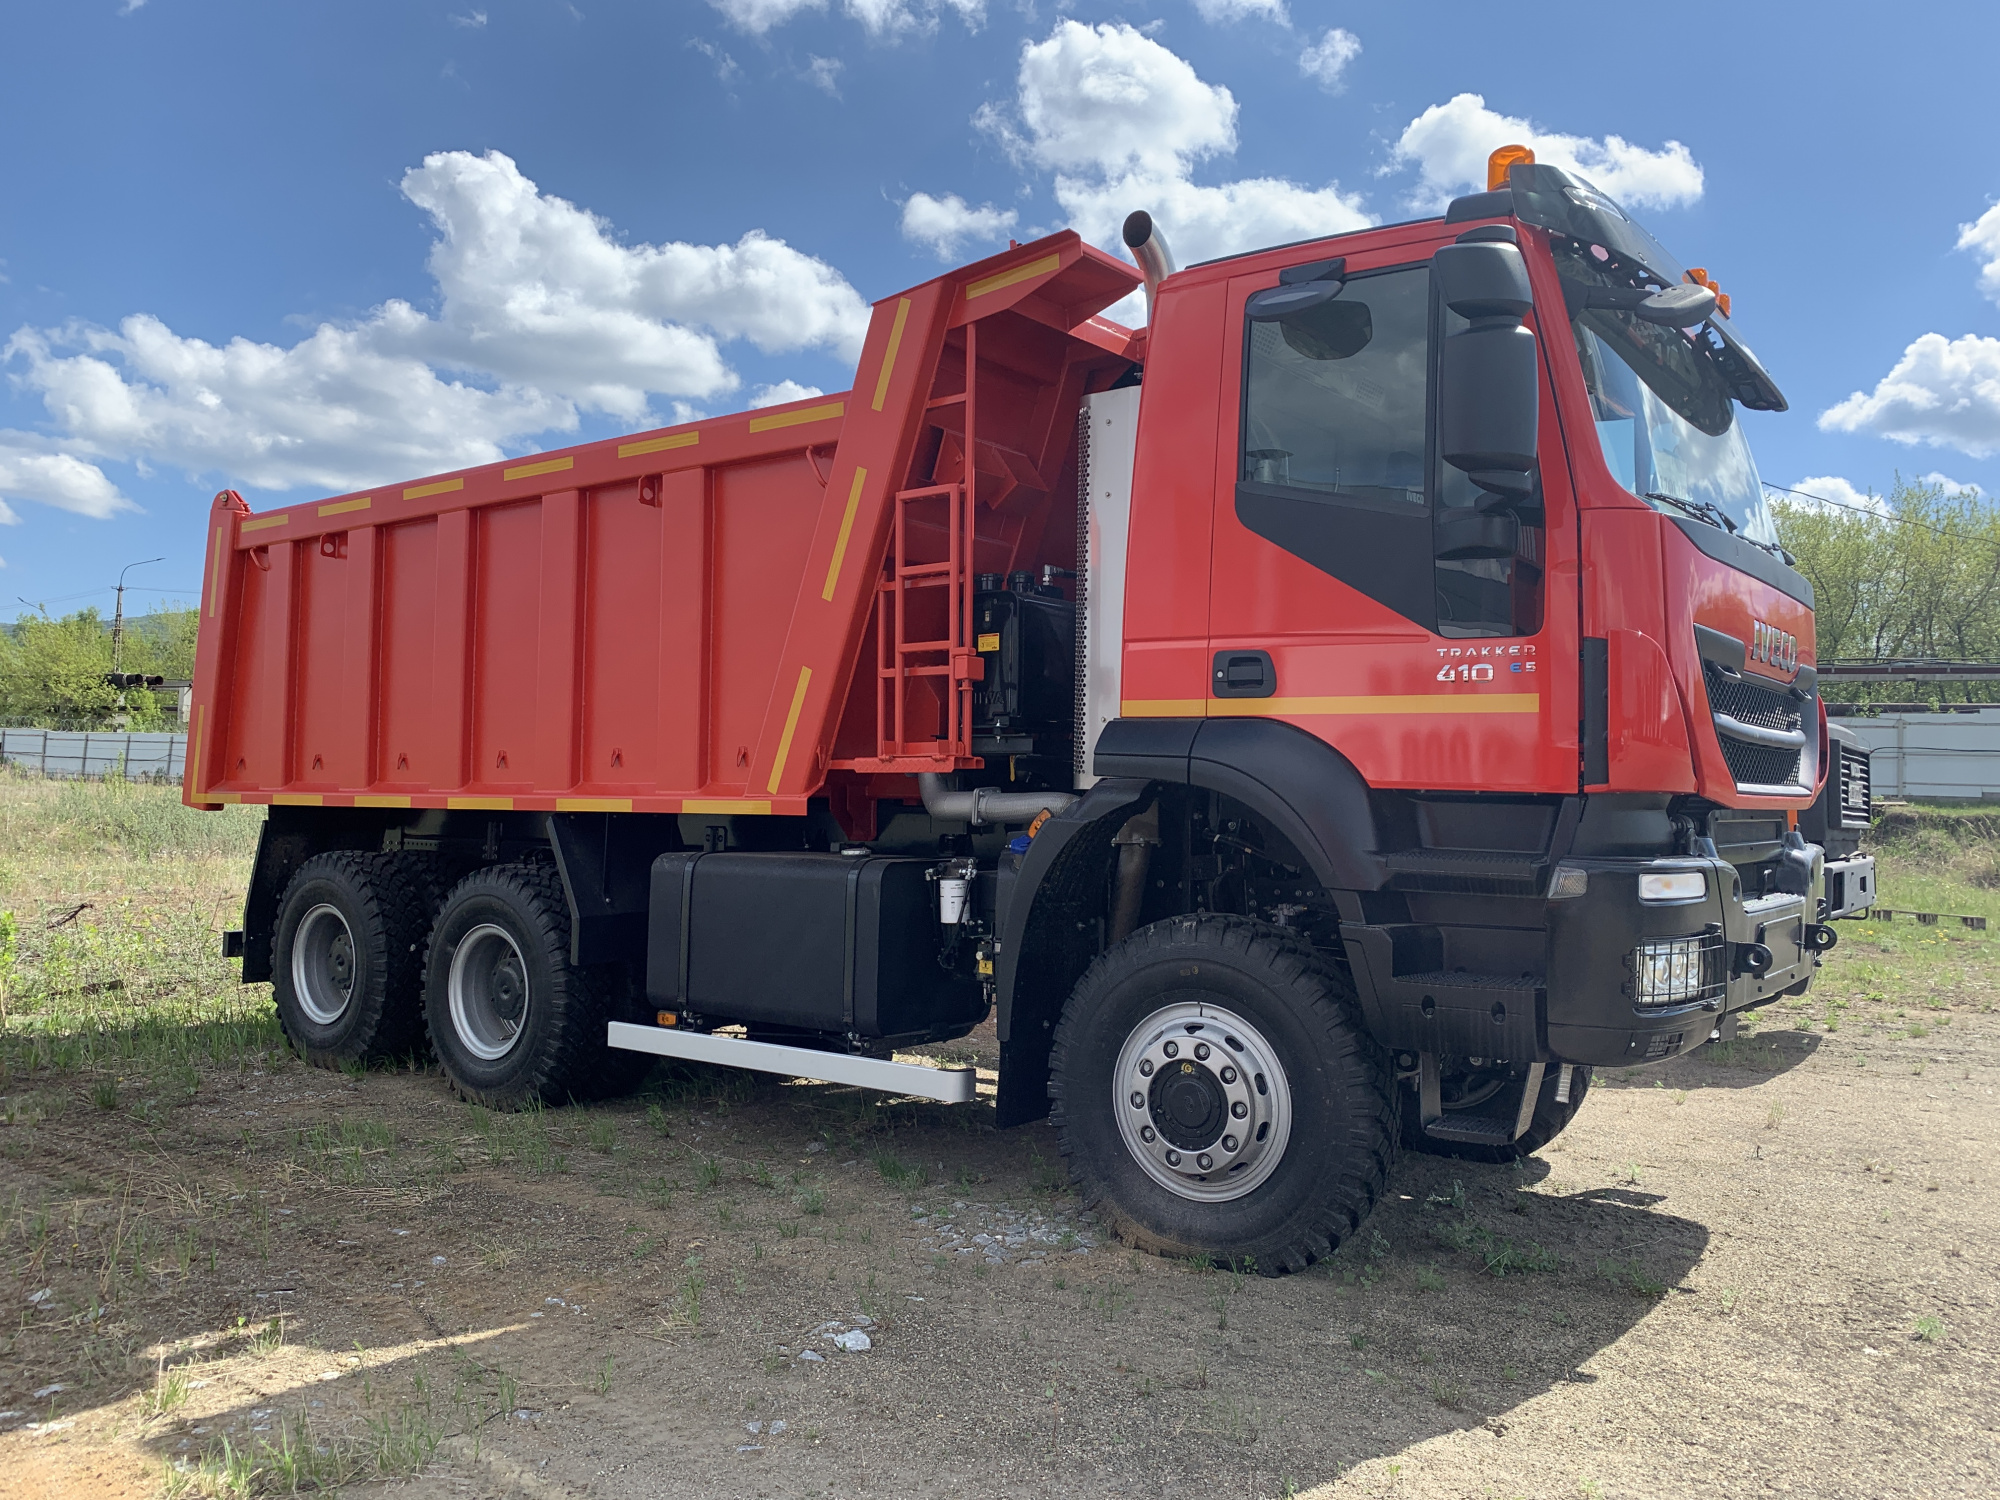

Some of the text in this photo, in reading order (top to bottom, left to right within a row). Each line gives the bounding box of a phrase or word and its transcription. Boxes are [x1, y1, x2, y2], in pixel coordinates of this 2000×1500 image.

[1436, 645, 1536, 658] TRAKKER
[1436, 662, 1536, 682] 410 E5
